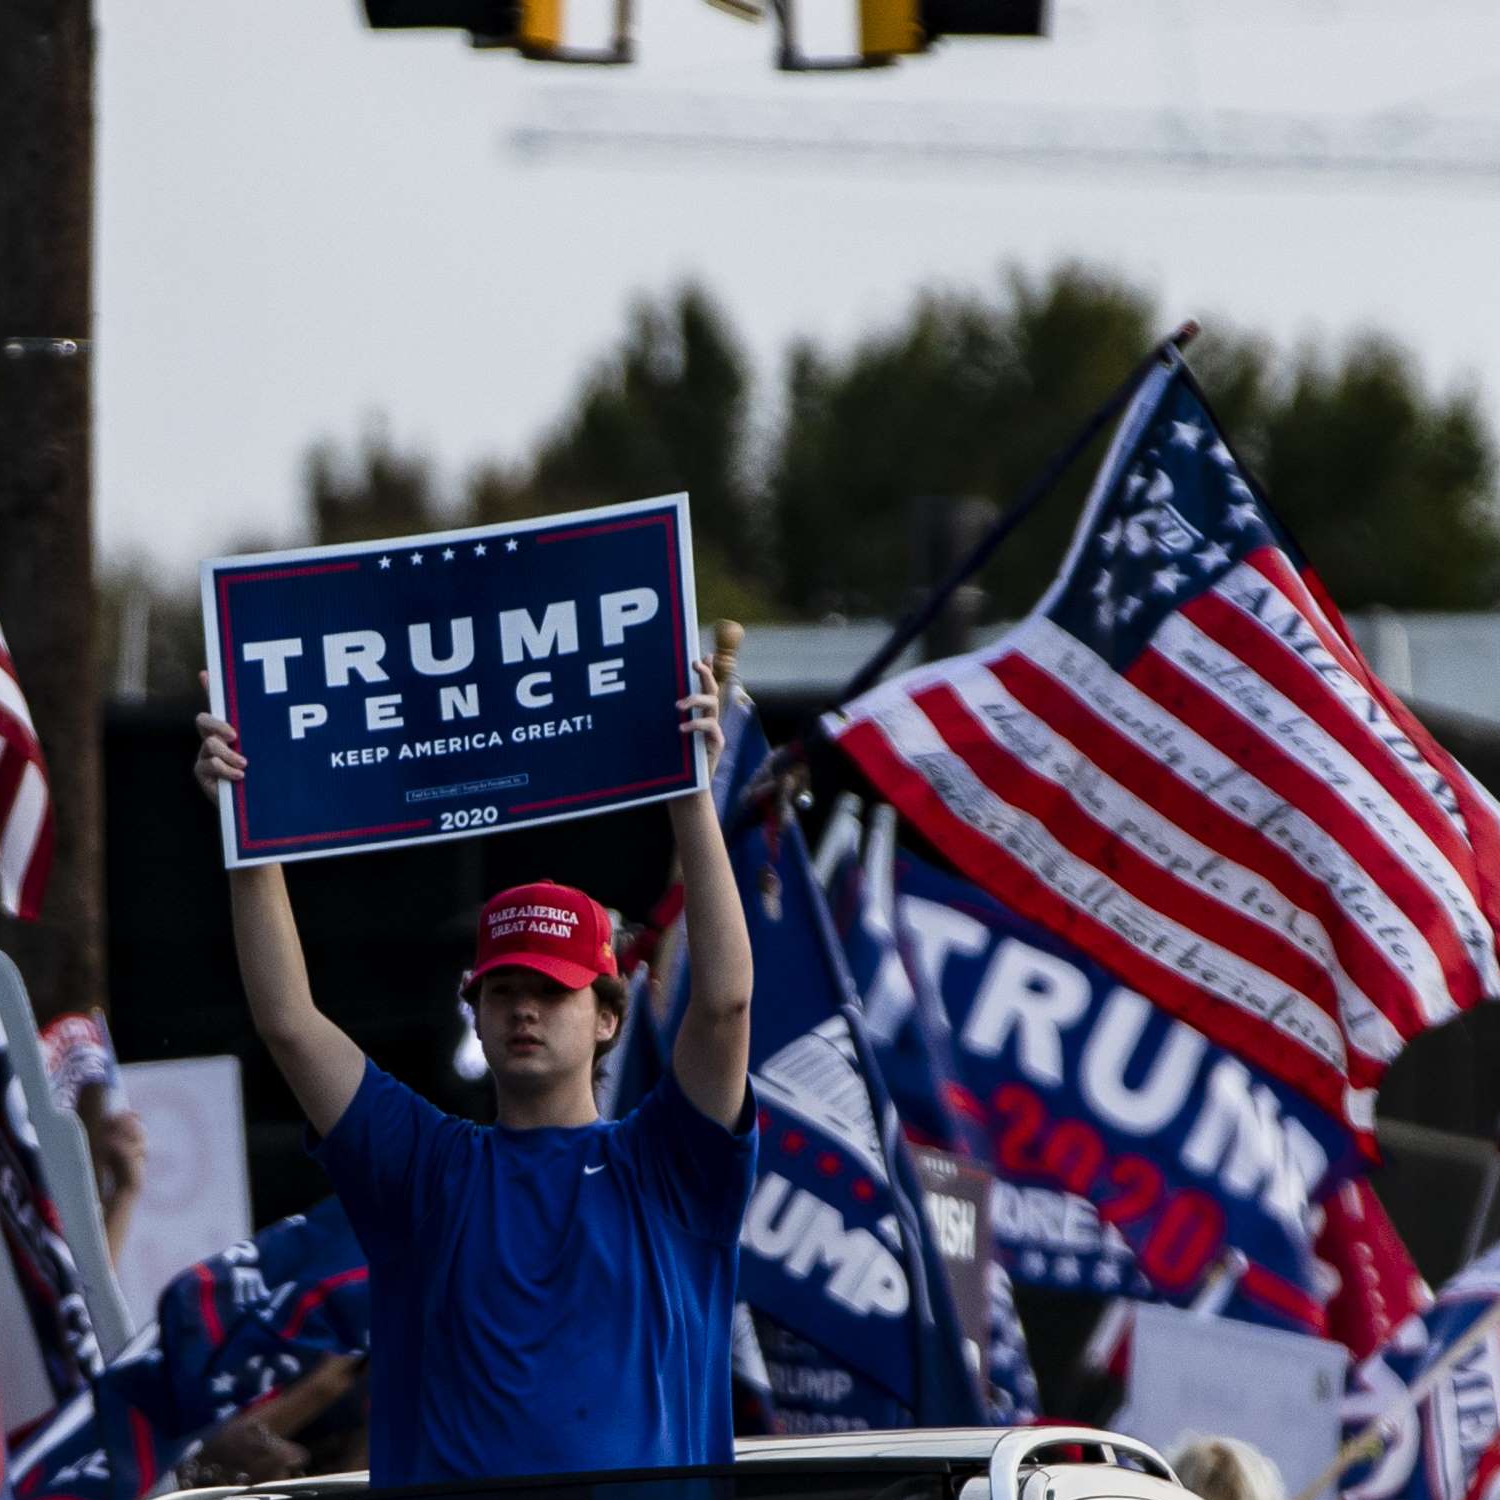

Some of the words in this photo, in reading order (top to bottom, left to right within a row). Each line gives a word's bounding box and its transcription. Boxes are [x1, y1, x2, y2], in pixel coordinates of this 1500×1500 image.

[243, 586, 659, 694] TRUMP
[289, 657, 626, 740] PENCE
[331, 745, 390, 768] KEEP
[398, 732, 503, 761] AMERICA
[511, 714, 594, 744] GREAT!
[440, 805, 498, 830] 2020
[487, 906, 517, 926] MAKE
[515, 904, 579, 926] AMERICA
[1240, 885, 1278, 917] to
[491, 920, 527, 940] GREAT
[528, 920, 572, 939] AGAIN
[1176, 940, 1220, 983] be
